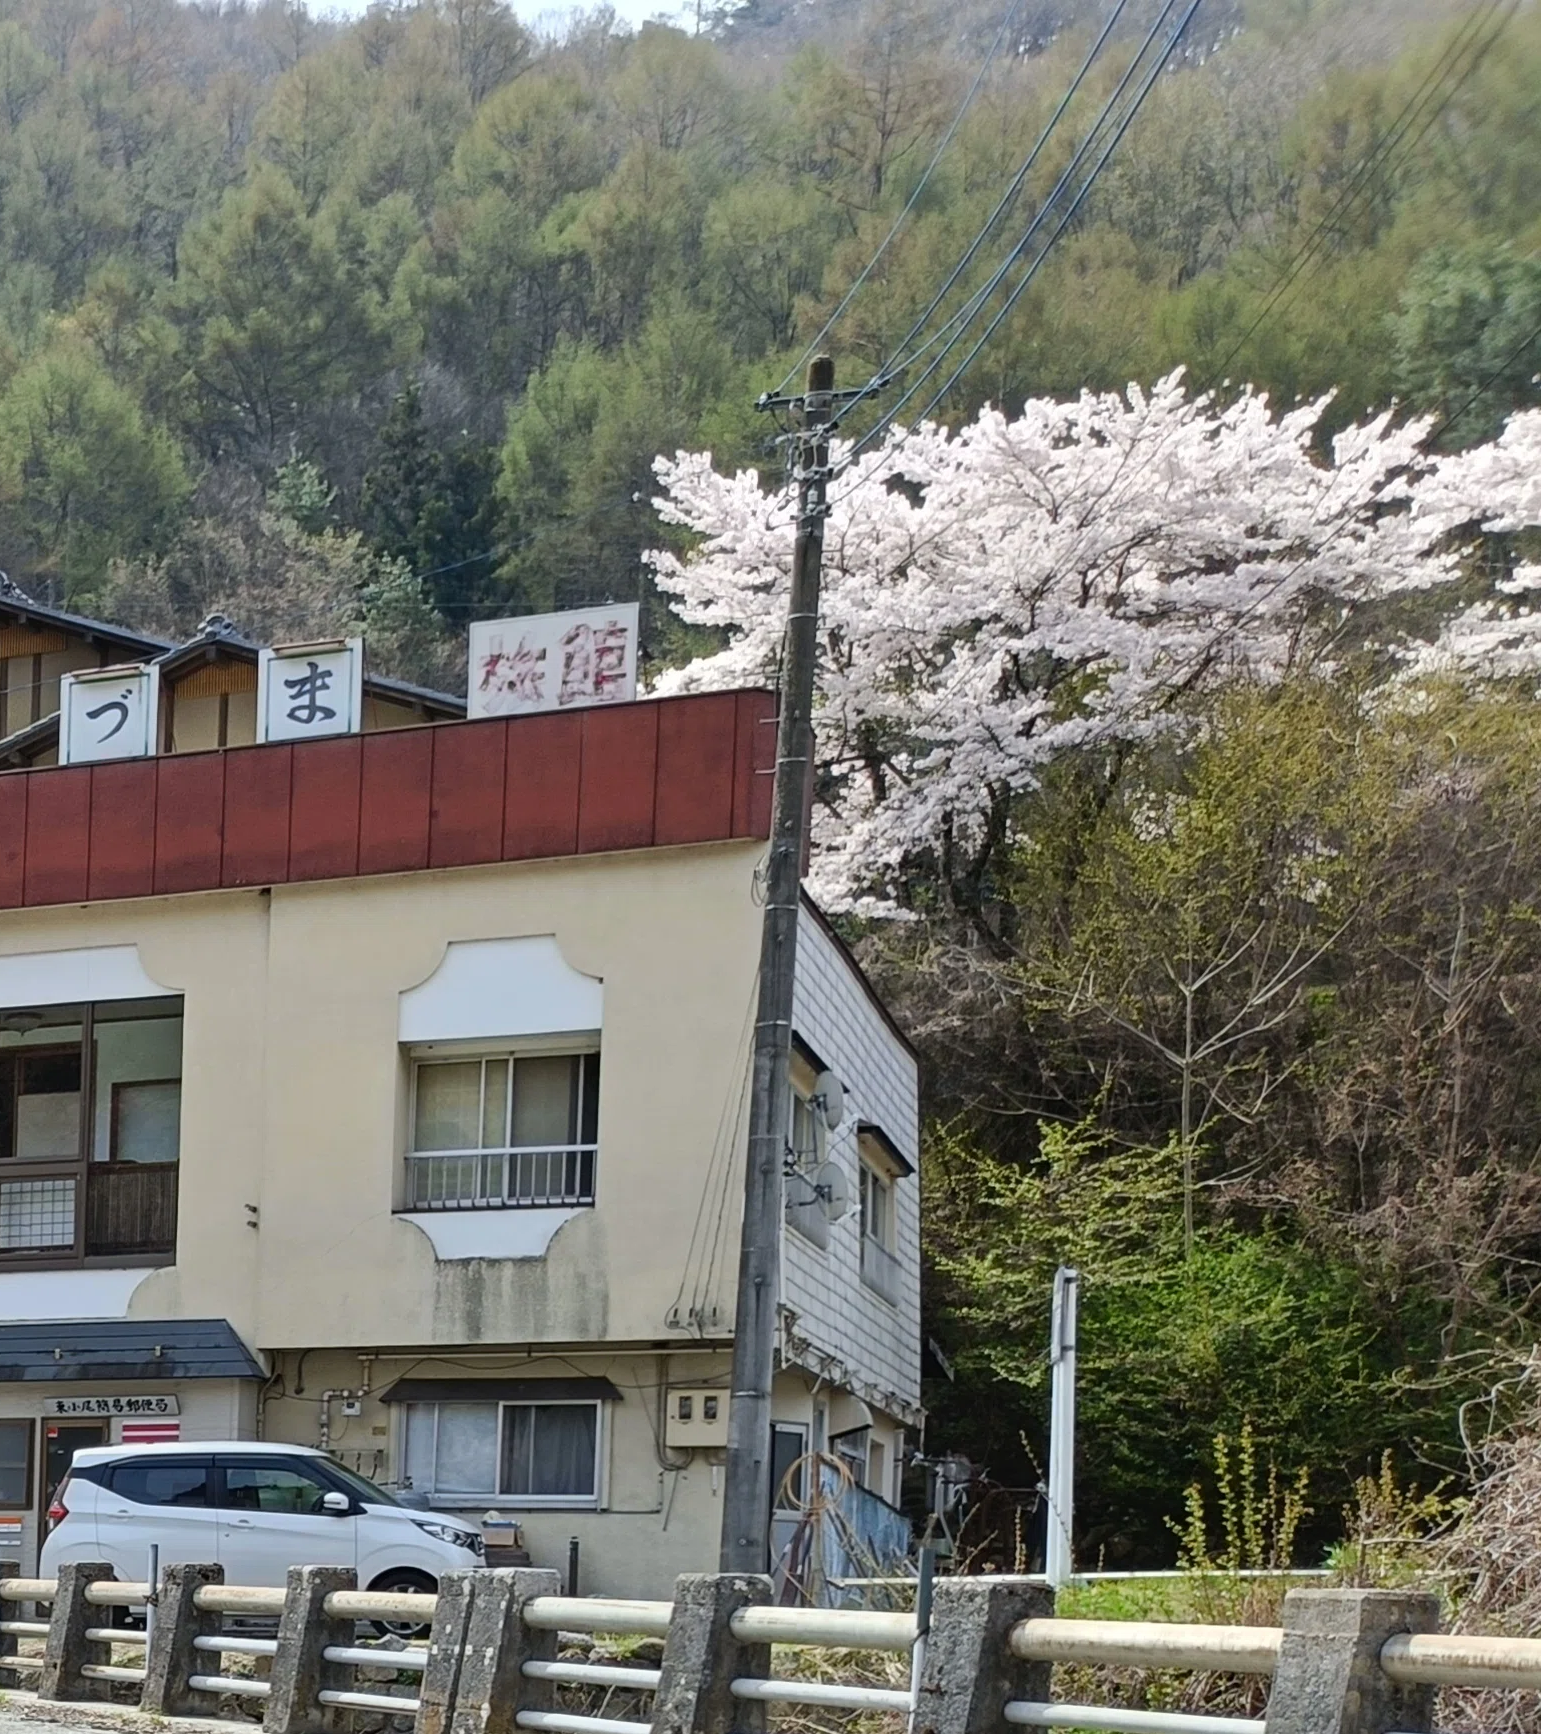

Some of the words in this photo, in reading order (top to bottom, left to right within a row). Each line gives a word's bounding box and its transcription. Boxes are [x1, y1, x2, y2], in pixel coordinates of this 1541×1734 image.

[55, 1397, 169, 1415] 東小尾簡易郵便局
